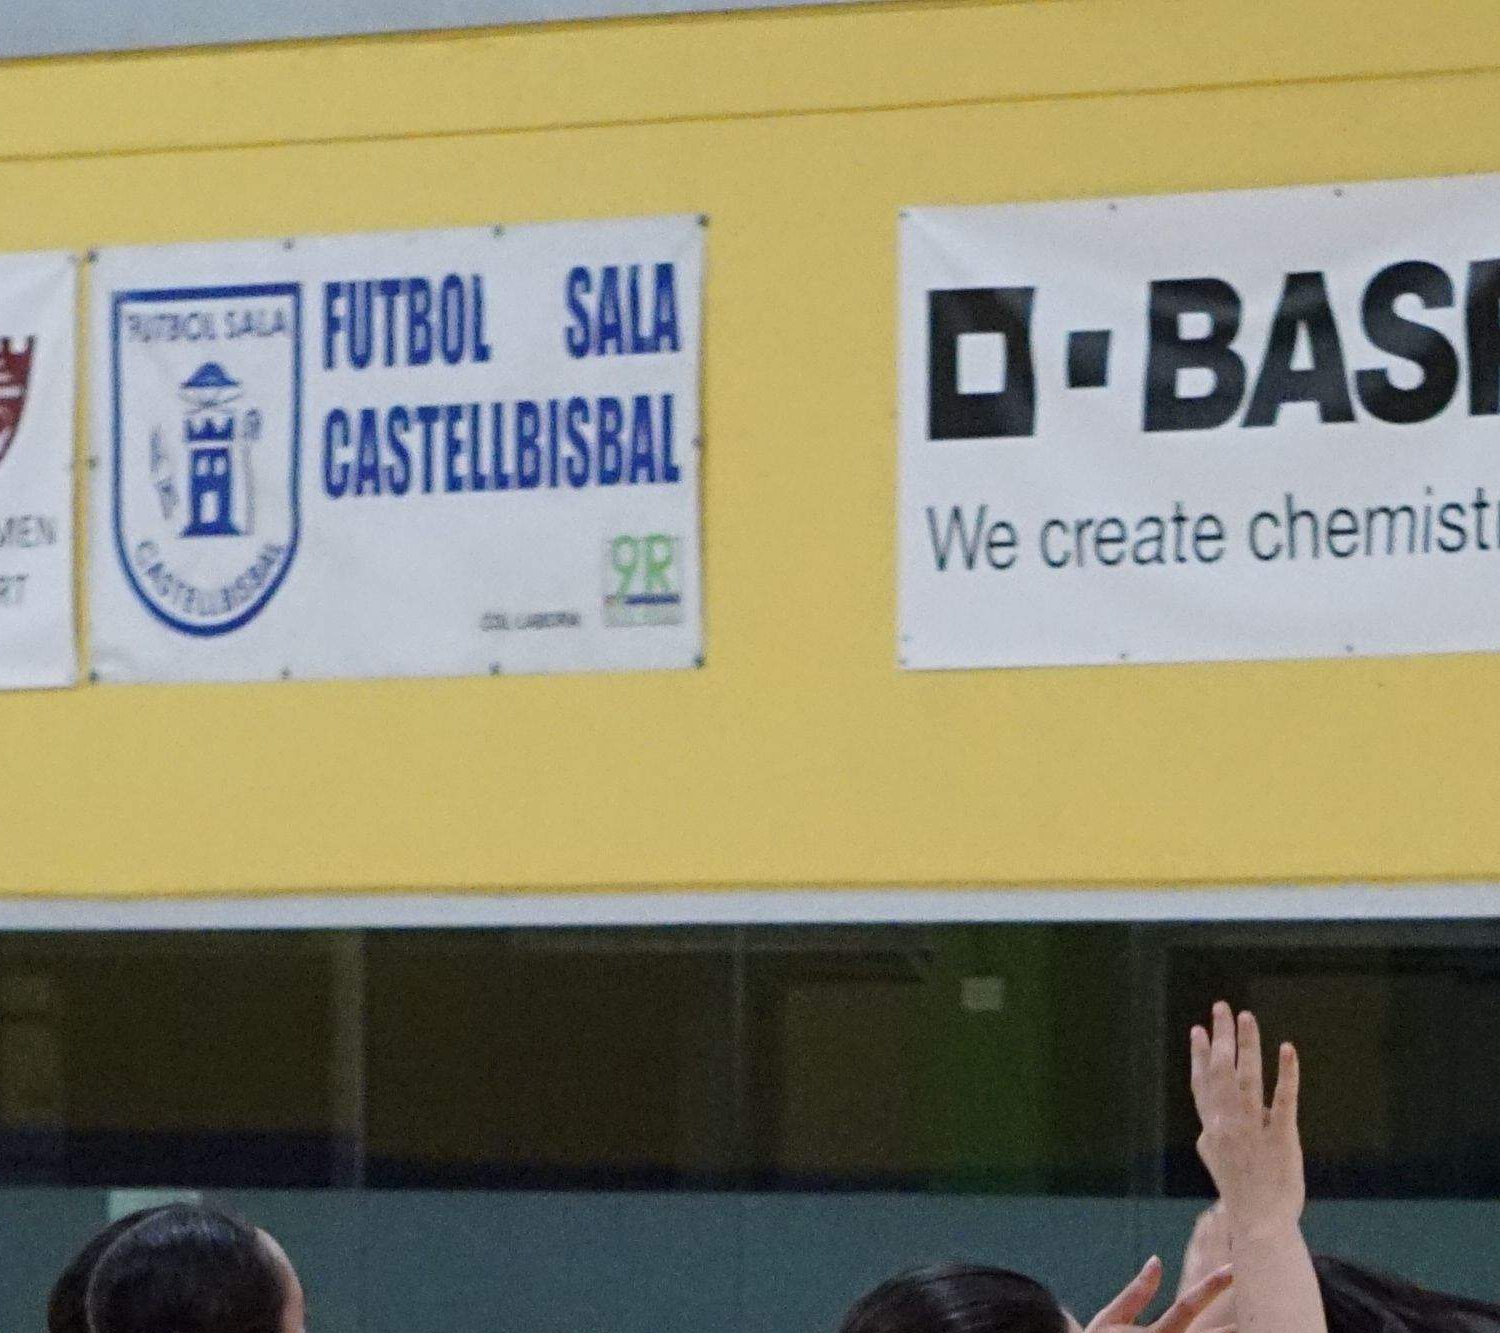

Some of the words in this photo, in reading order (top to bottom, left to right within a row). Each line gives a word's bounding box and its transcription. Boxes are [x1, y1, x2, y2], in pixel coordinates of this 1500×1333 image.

[322, 274, 491, 370] FUTBOL
[565, 263, 681, 359] SALA
[322, 394, 681, 497] CASTELLBISBAL
[928, 506, 1018, 570] We
[1040, 502, 1226, 568] create
